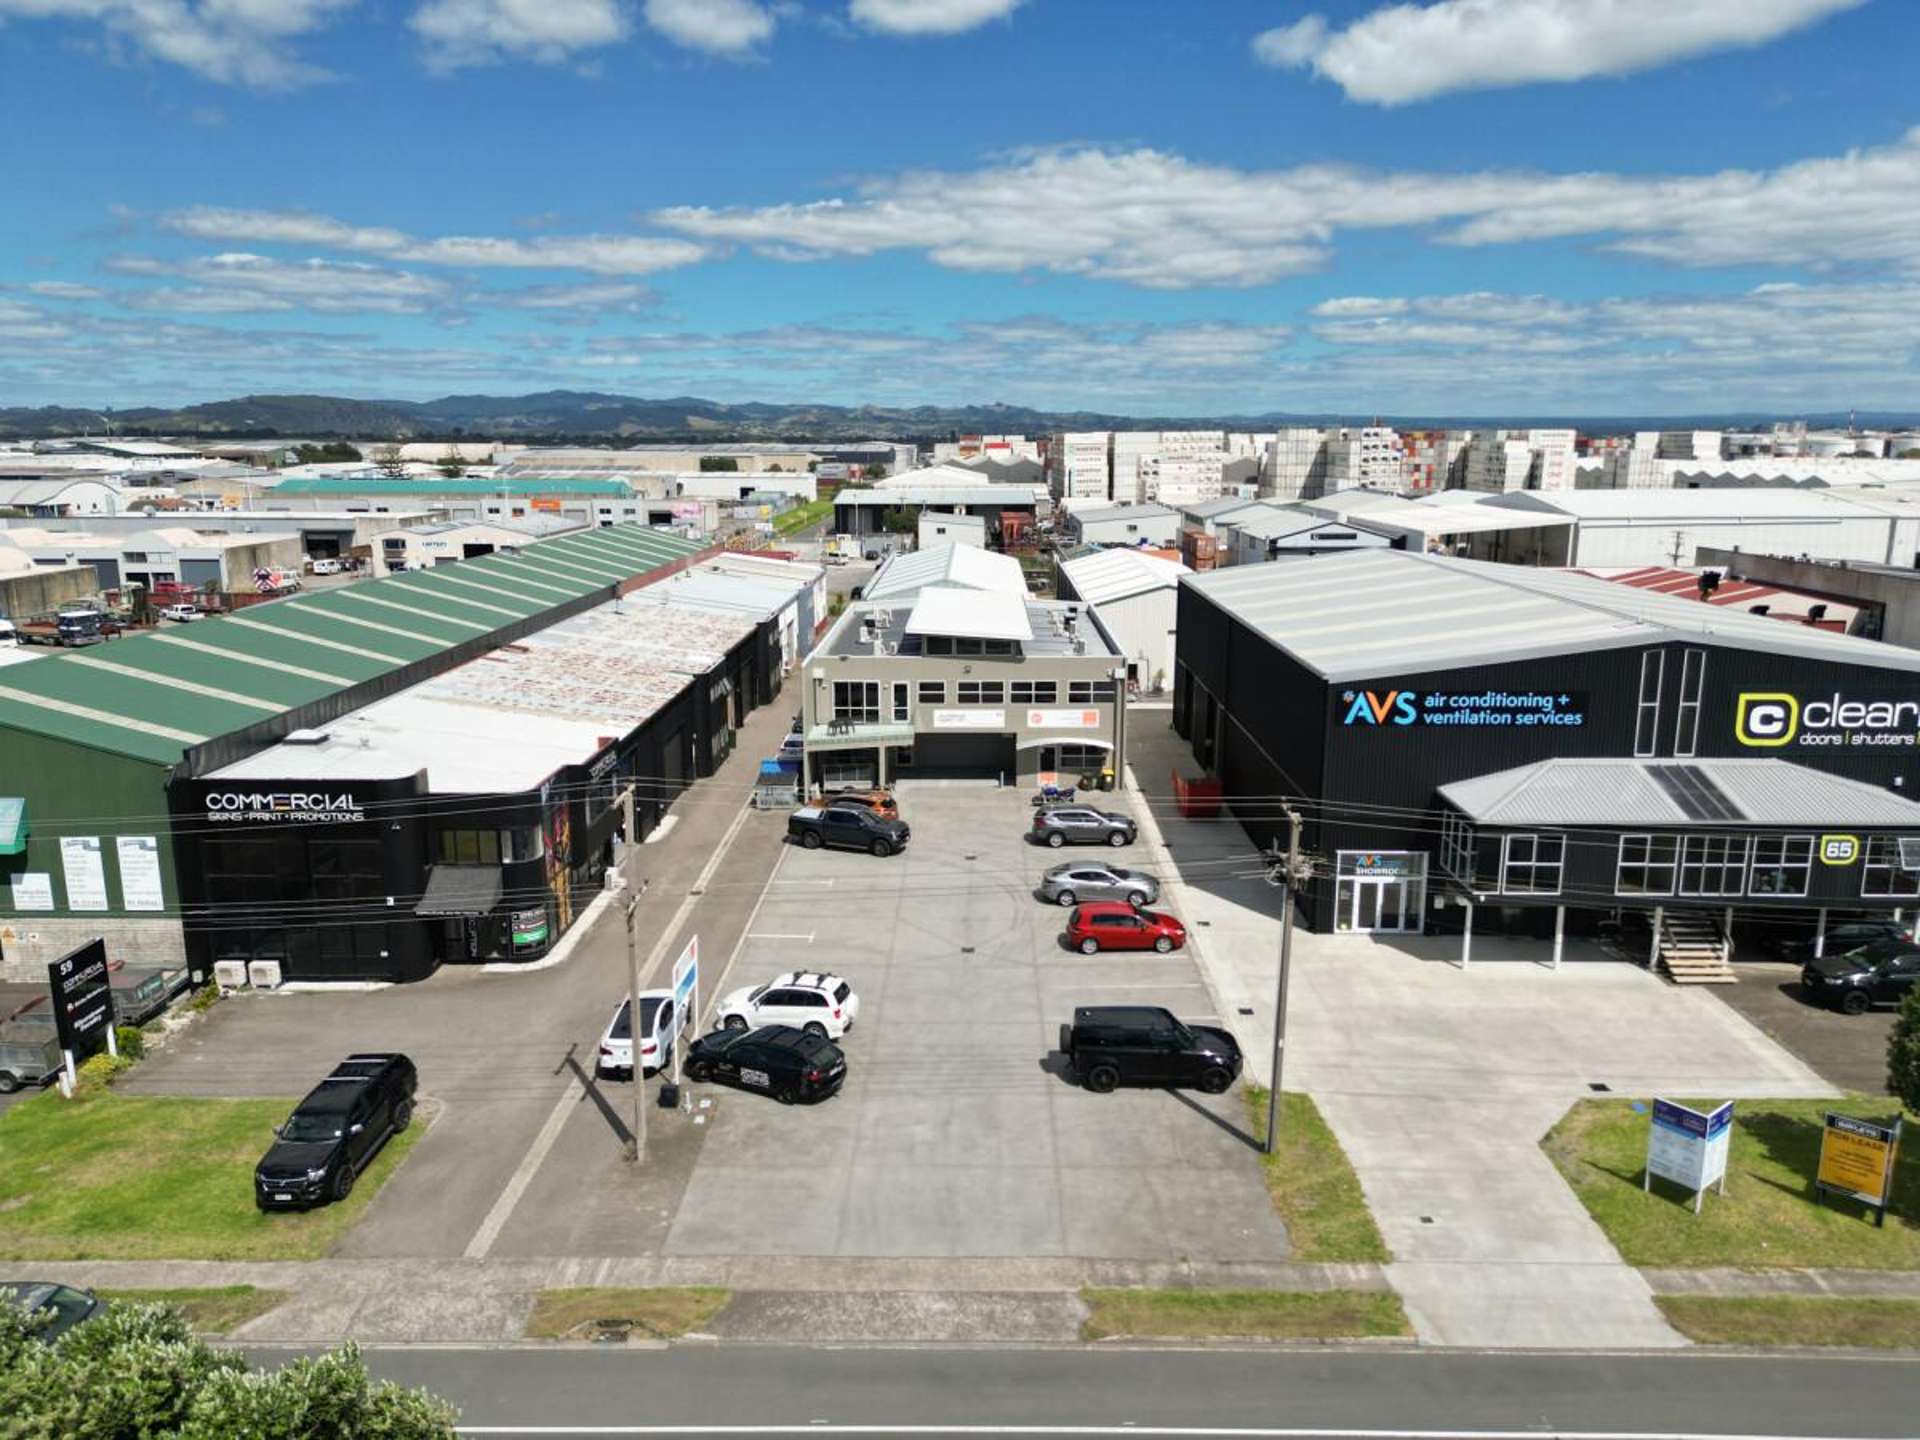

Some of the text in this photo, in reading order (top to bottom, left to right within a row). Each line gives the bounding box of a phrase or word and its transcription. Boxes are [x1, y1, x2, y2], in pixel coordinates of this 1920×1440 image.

[1344, 691, 1417, 725] AVS
[1424, 692, 1445, 708] air
[1449, 692, 1553, 712] conditioning
[1802, 692, 1920, 728] clear
[1423, 709, 1583, 725] ventilation services
[1799, 731, 1915, 745] doors shutters
[205, 793, 364, 811] COMMERCIAL
[207, 811, 365, 822] SIGNS PRINT PROMOTIONS
[1826, 842, 1852, 858] 65
[1355, 855, 1383, 866] AVS
[60, 960, 73, 976] 59
